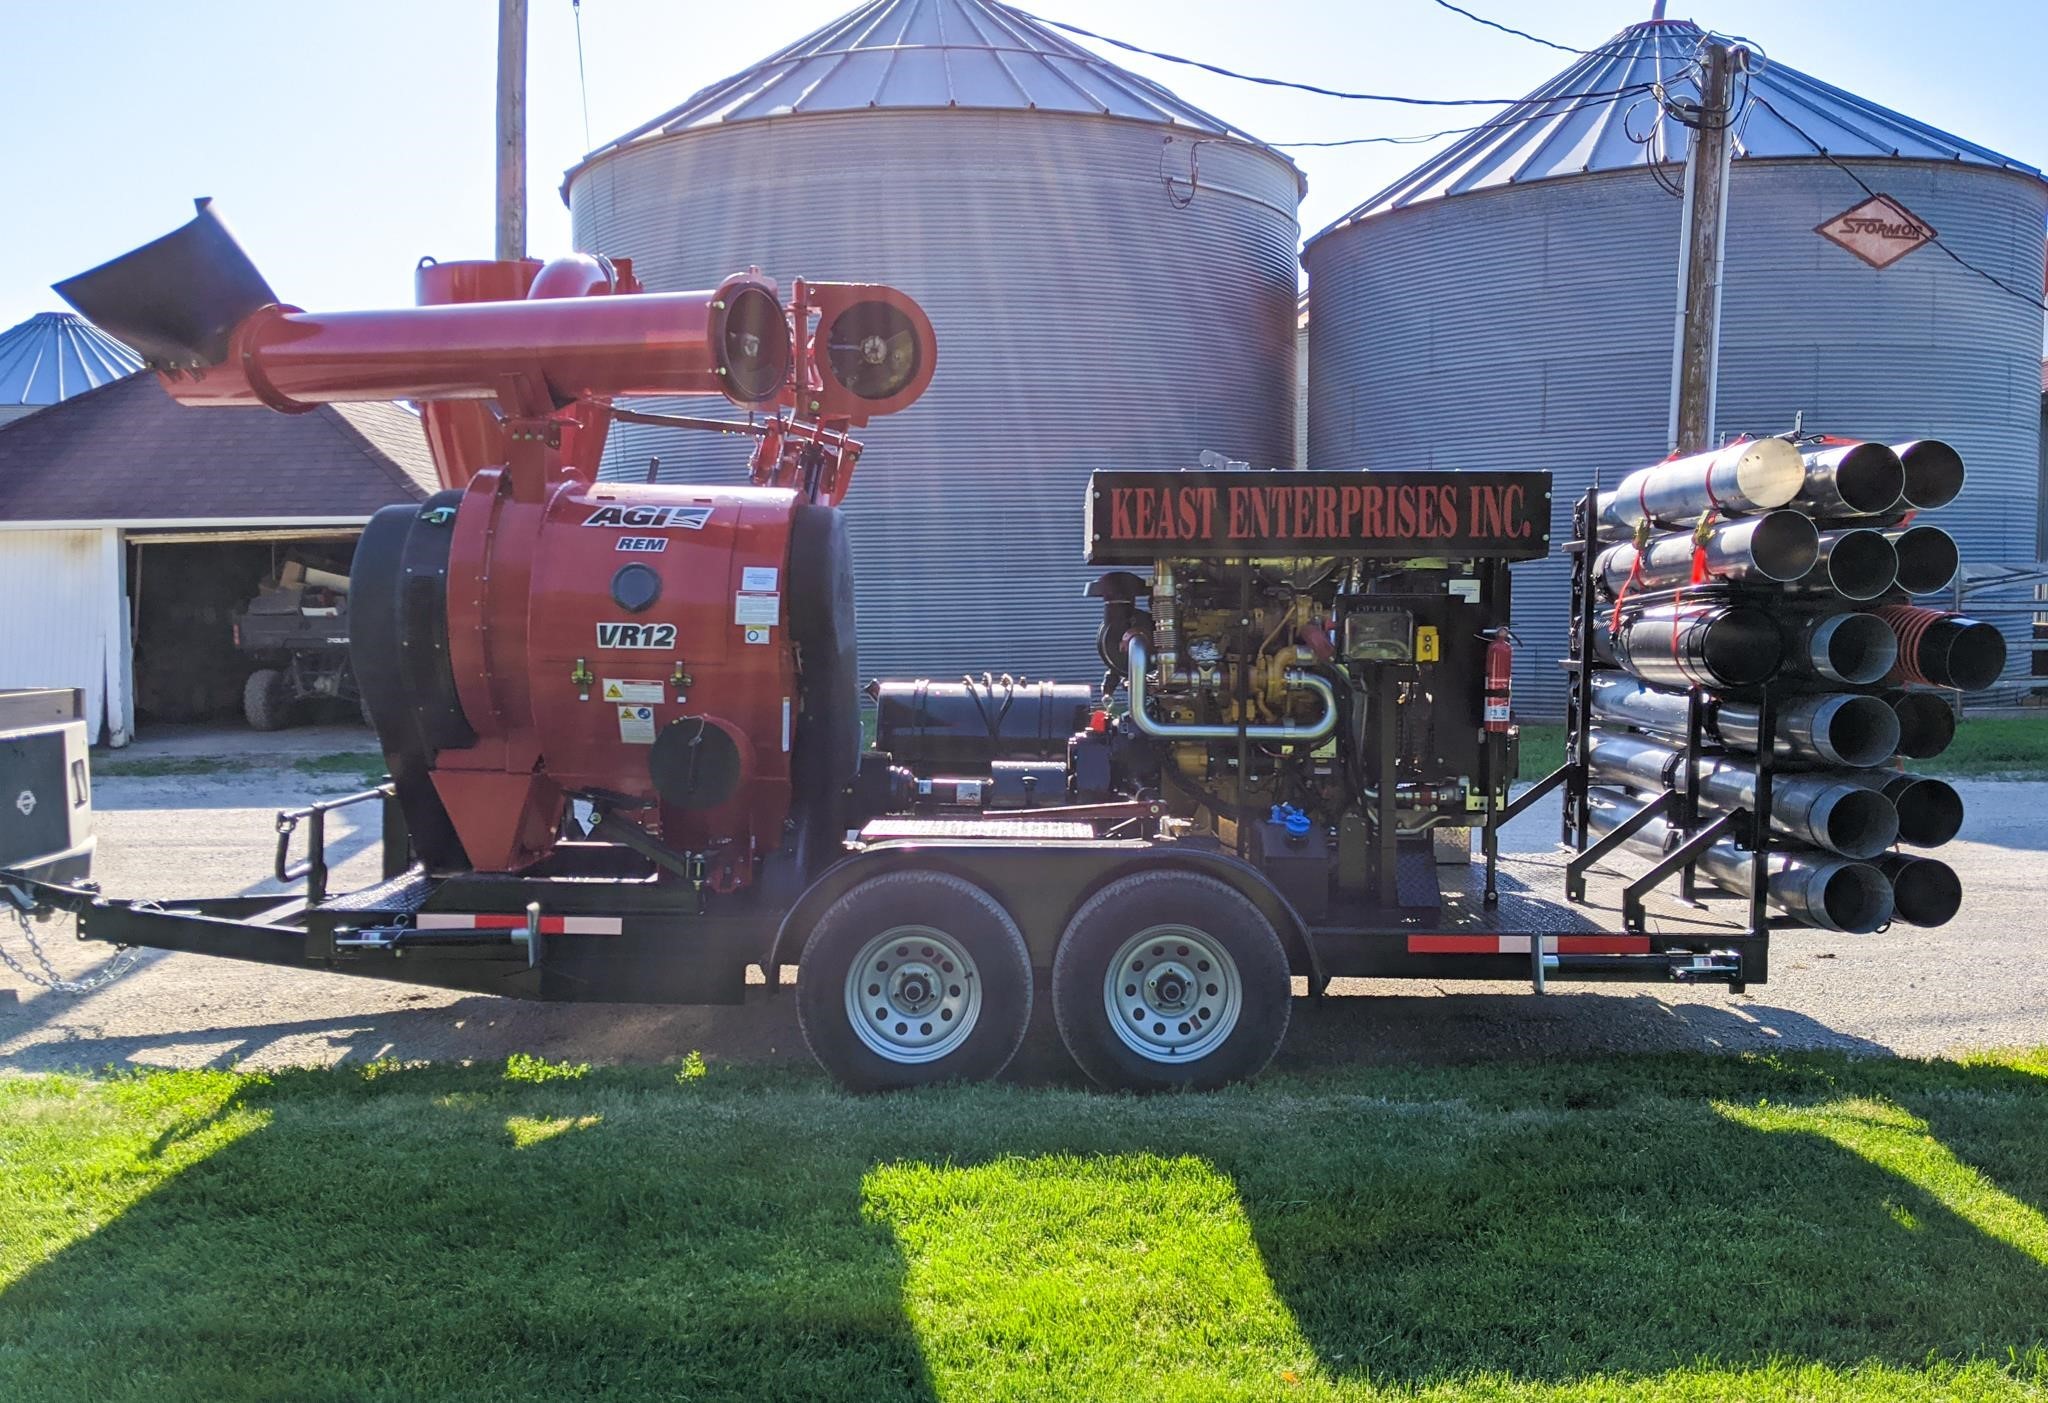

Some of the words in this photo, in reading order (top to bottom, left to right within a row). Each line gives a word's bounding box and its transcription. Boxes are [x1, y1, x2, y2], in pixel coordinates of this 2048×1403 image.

[588, 507, 669, 526] AGI
[1110, 486, 1216, 539] KEAST
[1227, 484, 1458, 539] ENTERPRISES
[1468, 484, 1531, 538] INC.
[618, 538, 665, 550] REM
[599, 625, 675, 647] VR12
